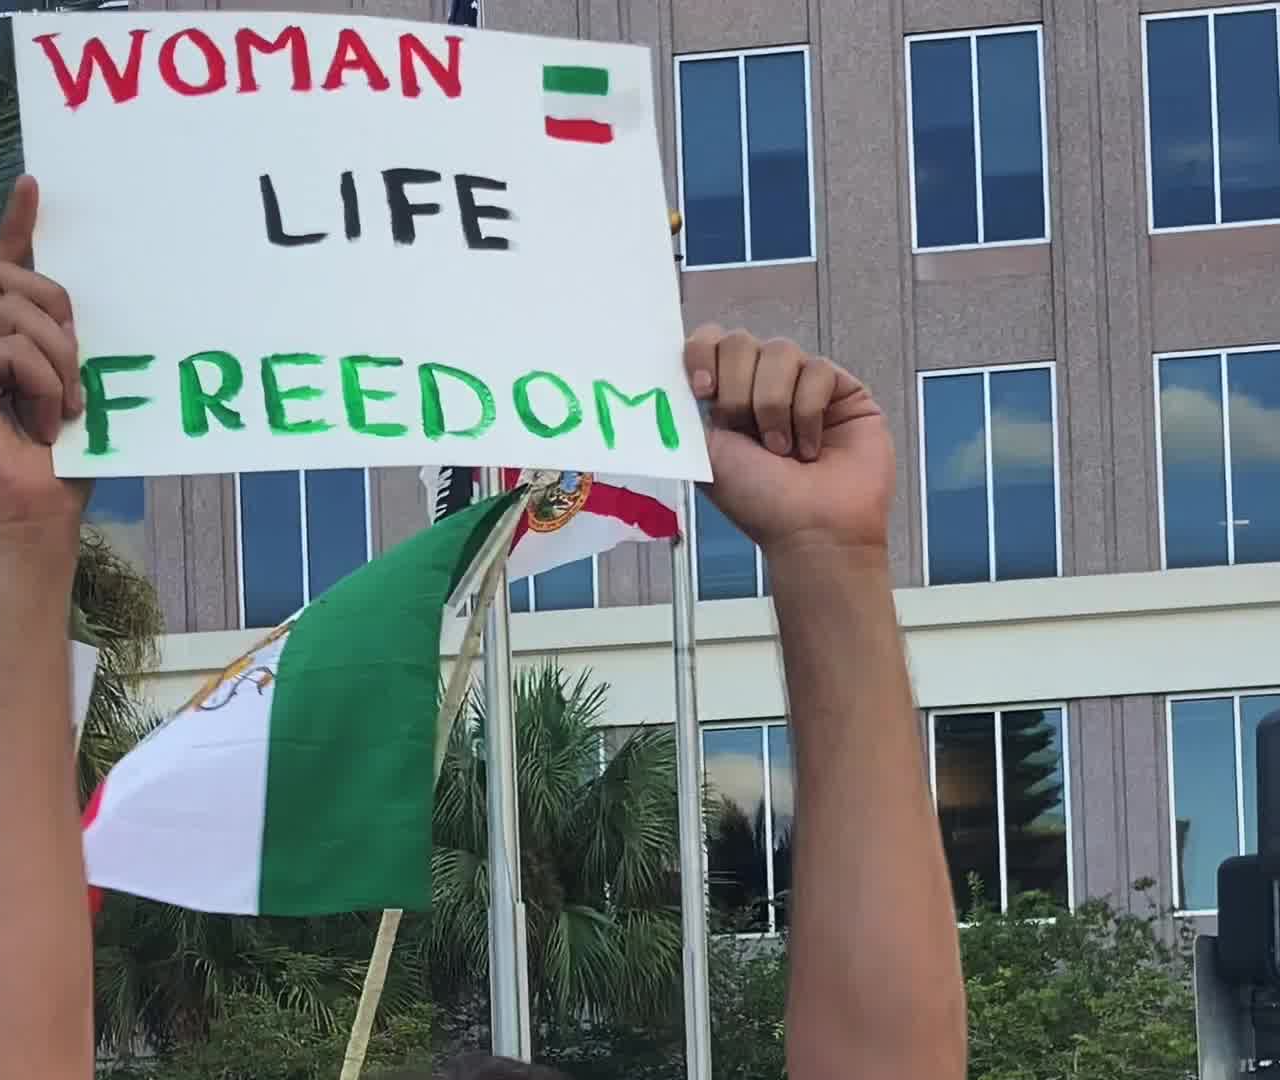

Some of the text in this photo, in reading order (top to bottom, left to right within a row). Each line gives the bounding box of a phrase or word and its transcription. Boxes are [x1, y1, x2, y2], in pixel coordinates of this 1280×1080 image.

[33, 25, 464, 111] WOMAN
[259, 168, 513, 251] LIFE
[80, 350, 680, 456] FREEDOM
